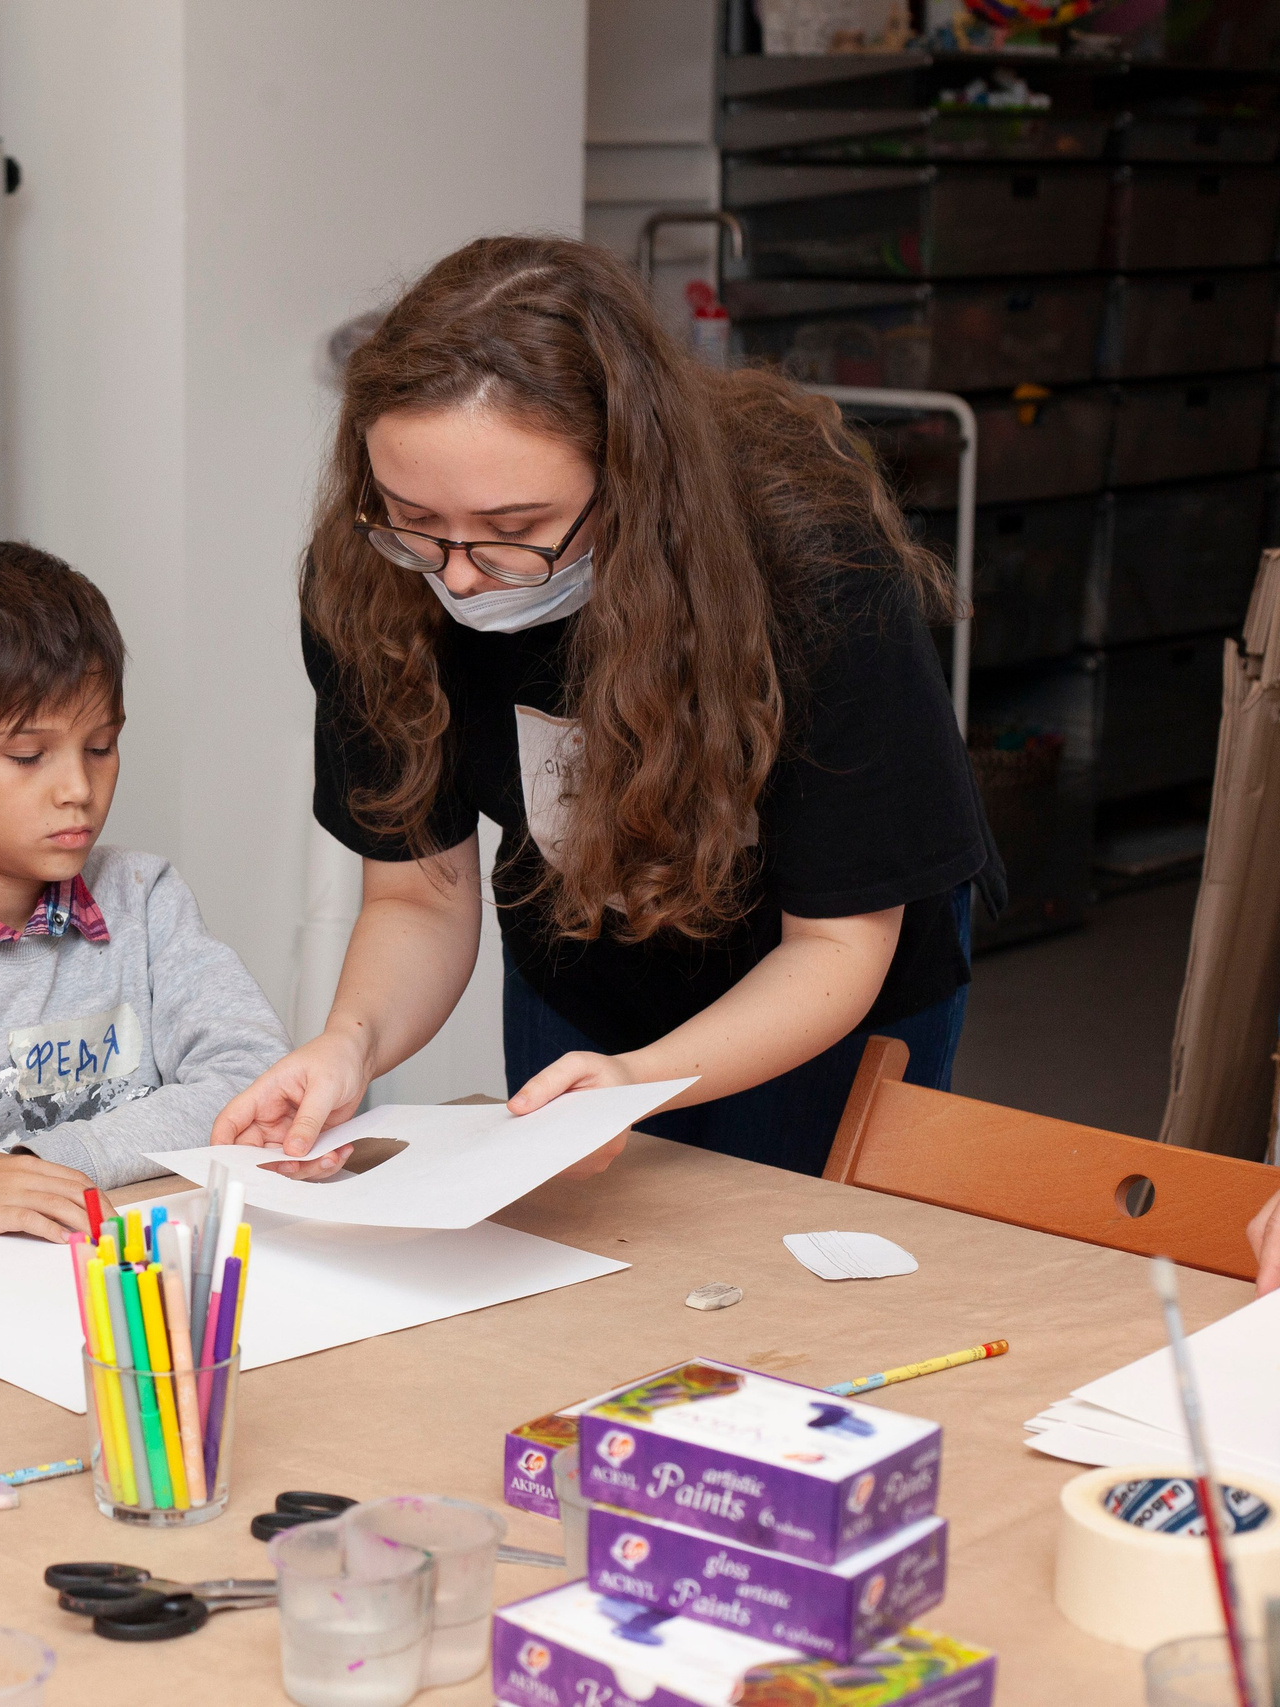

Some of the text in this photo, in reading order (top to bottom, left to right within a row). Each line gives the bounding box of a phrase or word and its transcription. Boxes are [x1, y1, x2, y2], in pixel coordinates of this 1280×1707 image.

[26, 1023, 120, 1085] ФЕДЯ
[511, 1476, 554, 1500] АКРИЛ
[645, 1462, 746, 1522] Paints
[702, 1550, 751, 1582] gloss
[668, 1577, 752, 1628] Paints
